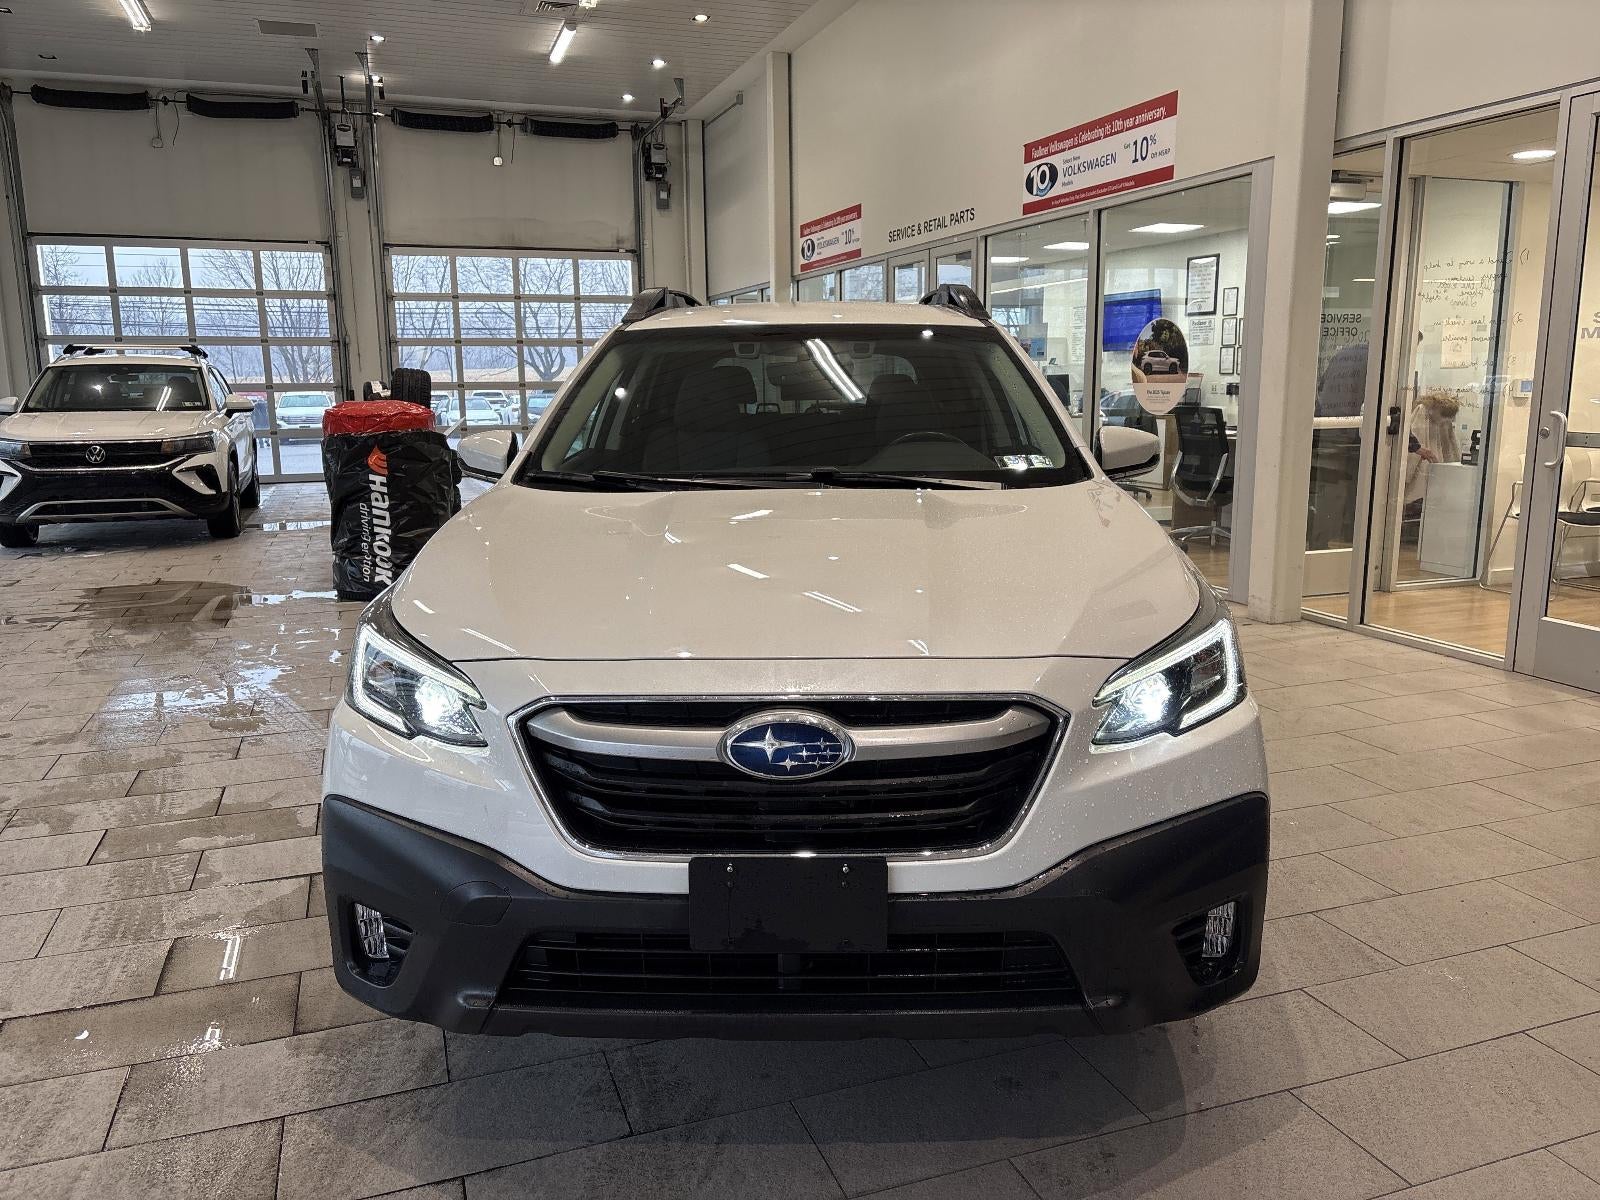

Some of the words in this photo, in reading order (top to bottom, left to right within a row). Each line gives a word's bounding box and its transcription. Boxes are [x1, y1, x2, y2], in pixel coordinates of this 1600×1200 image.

[1049, 138, 1074, 153] Volkswagen
[1074, 134, 1079, 144] is
[1078, 126, 1104, 145] Celebrating
[1111, 119, 1123, 133] 10th
[1123, 117, 1135, 132] year
[1135, 106, 1167, 125] anniversary.
[1062, 152, 1117, 178] VOLKSWAGEN
[888, 224, 916, 243] SERVICE
[916, 223, 922, 236] &
[923, 215, 948, 233] RETAIL
[950, 207, 975, 227] PARTS
[359, 502, 371, 542] driving
[368, 474, 393, 586] Hankook
